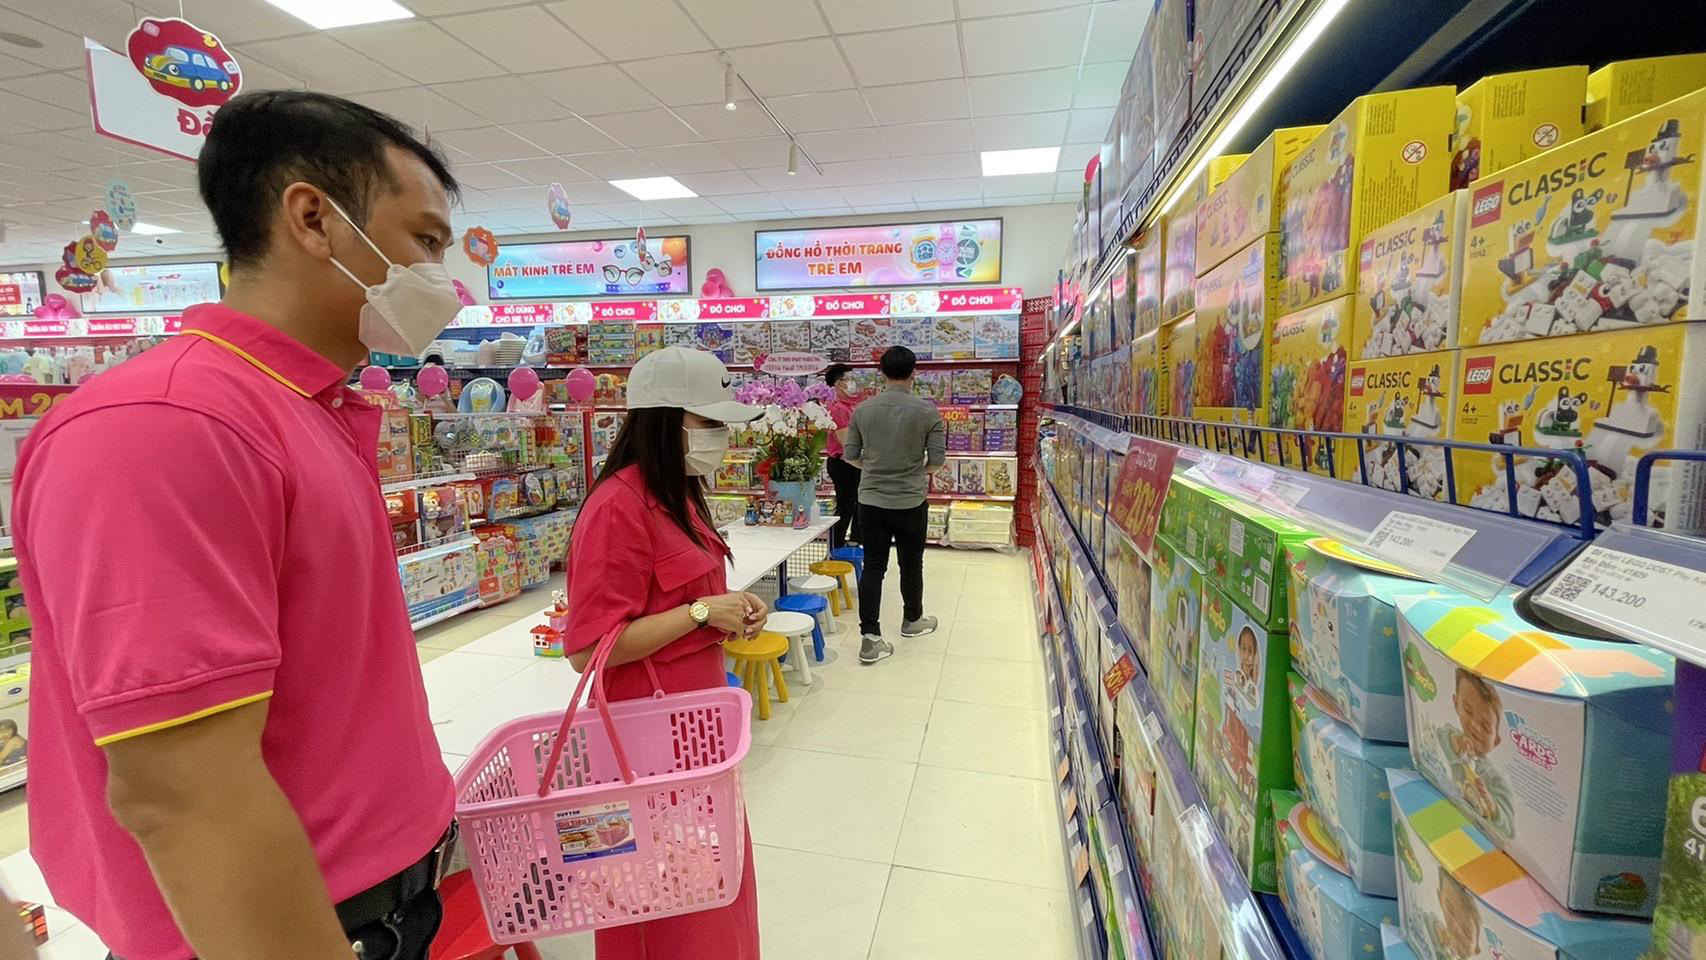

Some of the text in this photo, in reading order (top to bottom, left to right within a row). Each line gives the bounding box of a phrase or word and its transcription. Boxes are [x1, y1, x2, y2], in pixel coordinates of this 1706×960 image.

[1474, 151, 1608, 215] LEGO CLASSIC
[766, 240, 903, 259] ĐỒNG HỒ THỜI TRANG
[1375, 226, 1417, 258] CLASSIC
[493, 260, 519, 278] MẮT
[551, 260, 573, 275] TRẺ
[576, 263, 595, 274] EM
[808, 258, 862, 275] TRẺ EM
[725, 303, 746, 314] CHƠI
[841, 299, 864, 310] CHƠI
[967, 295, 993, 305] CHƠI
[615, 306, 635, 317] CHƠI
[1466, 356, 1592, 385] LEGO CLASSIC
[1367, 371, 1411, 389] CLASSIC
[1462, 402, 1477, 414] 4+
[1591, 583, 1647, 609] 143,200
[1509, 728, 1559, 765] CARDS
